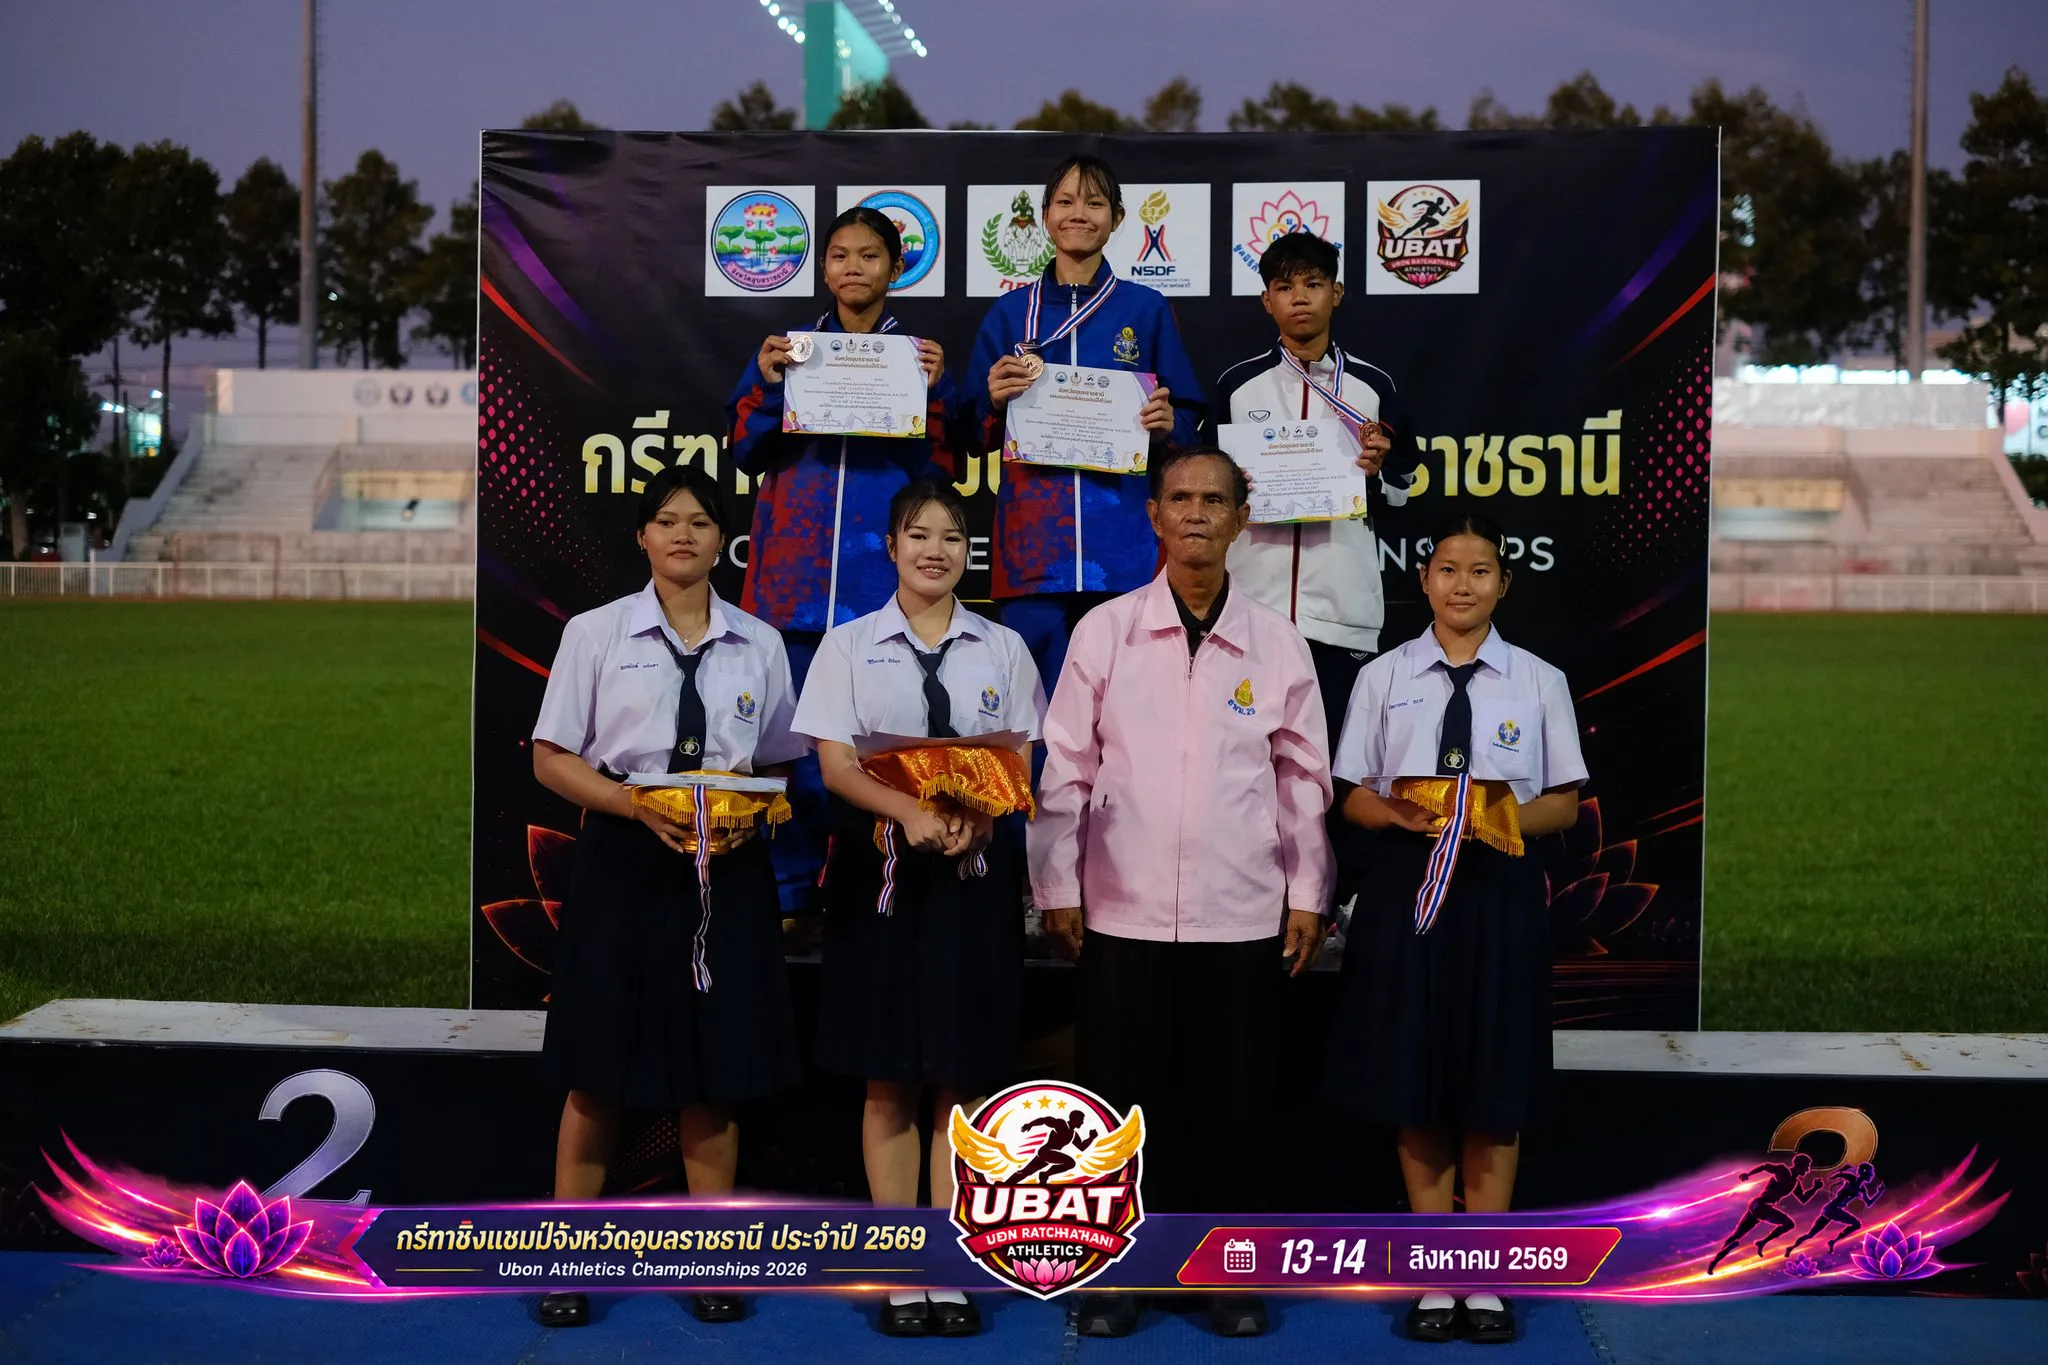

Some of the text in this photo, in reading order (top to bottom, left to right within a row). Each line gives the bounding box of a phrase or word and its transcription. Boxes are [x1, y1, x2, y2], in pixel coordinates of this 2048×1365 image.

[1384, 238, 1462, 259] UBAT
[1131, 265, 1176, 276] NSDF
[258, 1068, 376, 1208] 2
